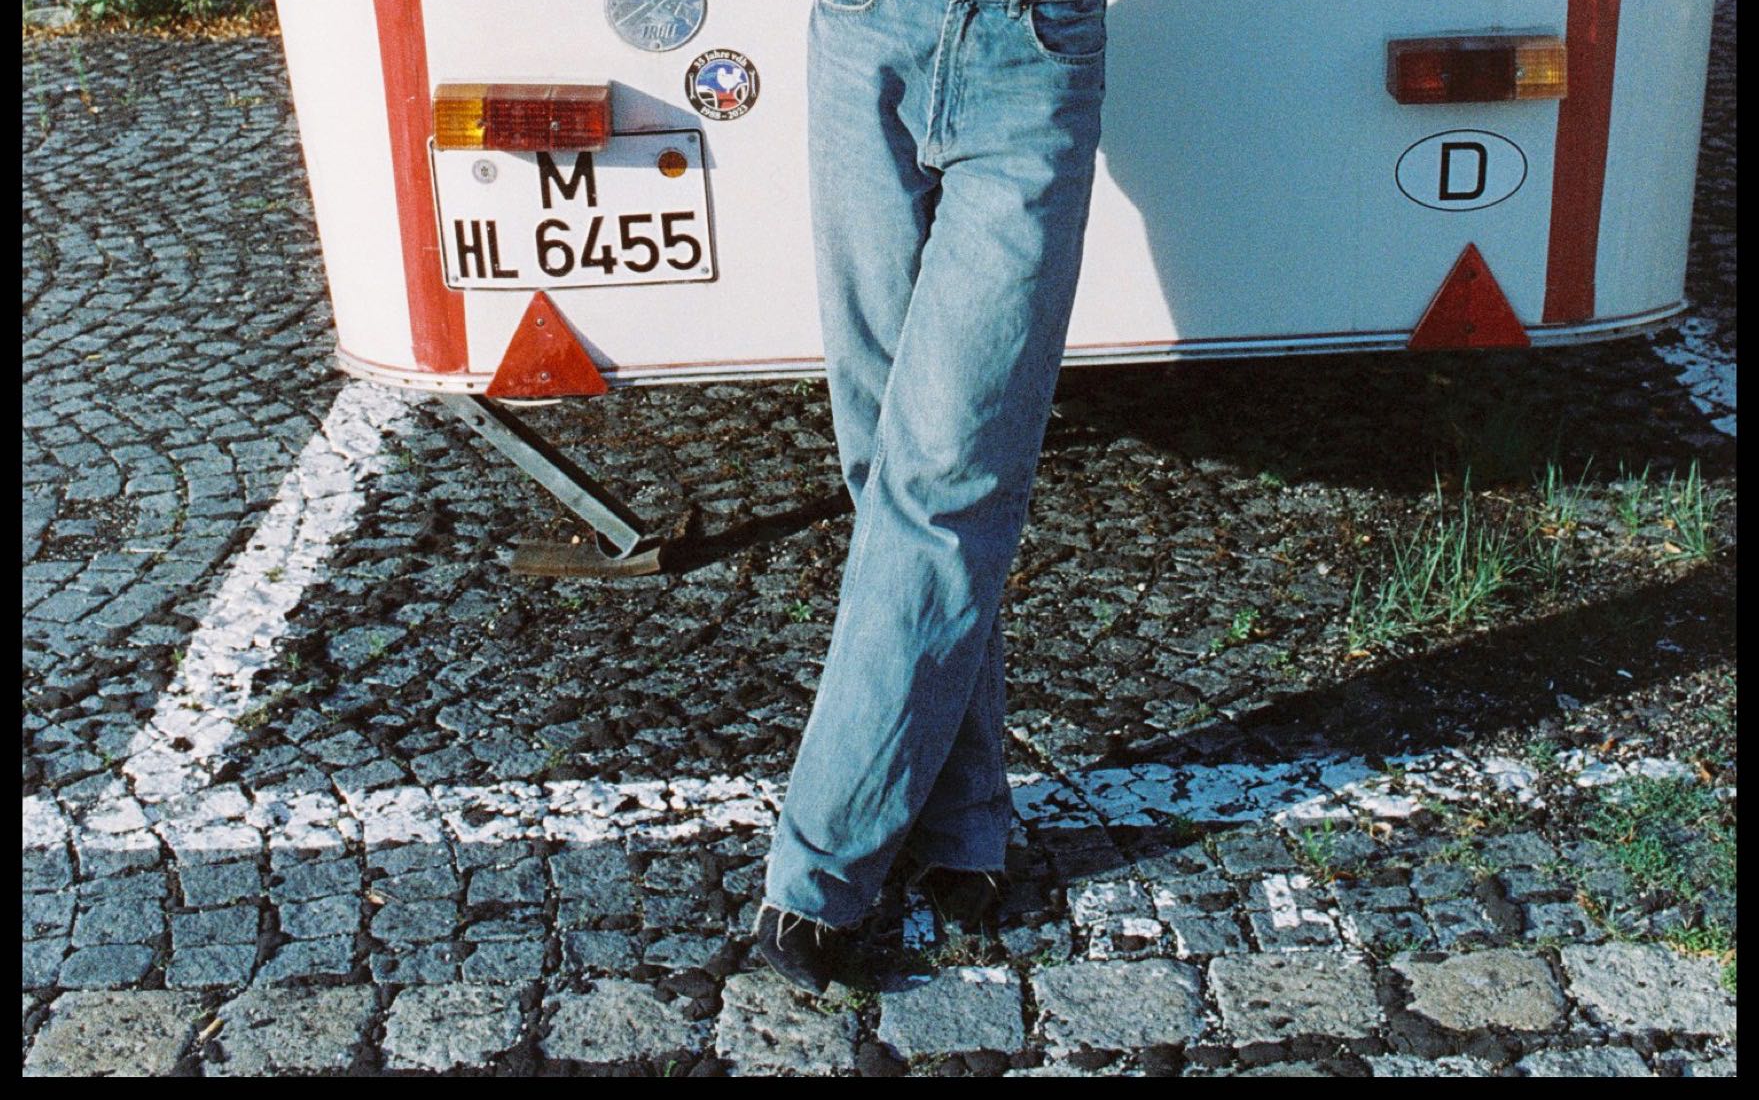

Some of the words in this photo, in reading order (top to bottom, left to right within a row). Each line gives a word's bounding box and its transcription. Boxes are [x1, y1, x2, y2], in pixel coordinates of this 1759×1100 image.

[536, 151, 597, 209] M
[1439, 142, 1487, 200] D
[454, 220, 519, 279] HL
[535, 211, 702, 278] 6455
